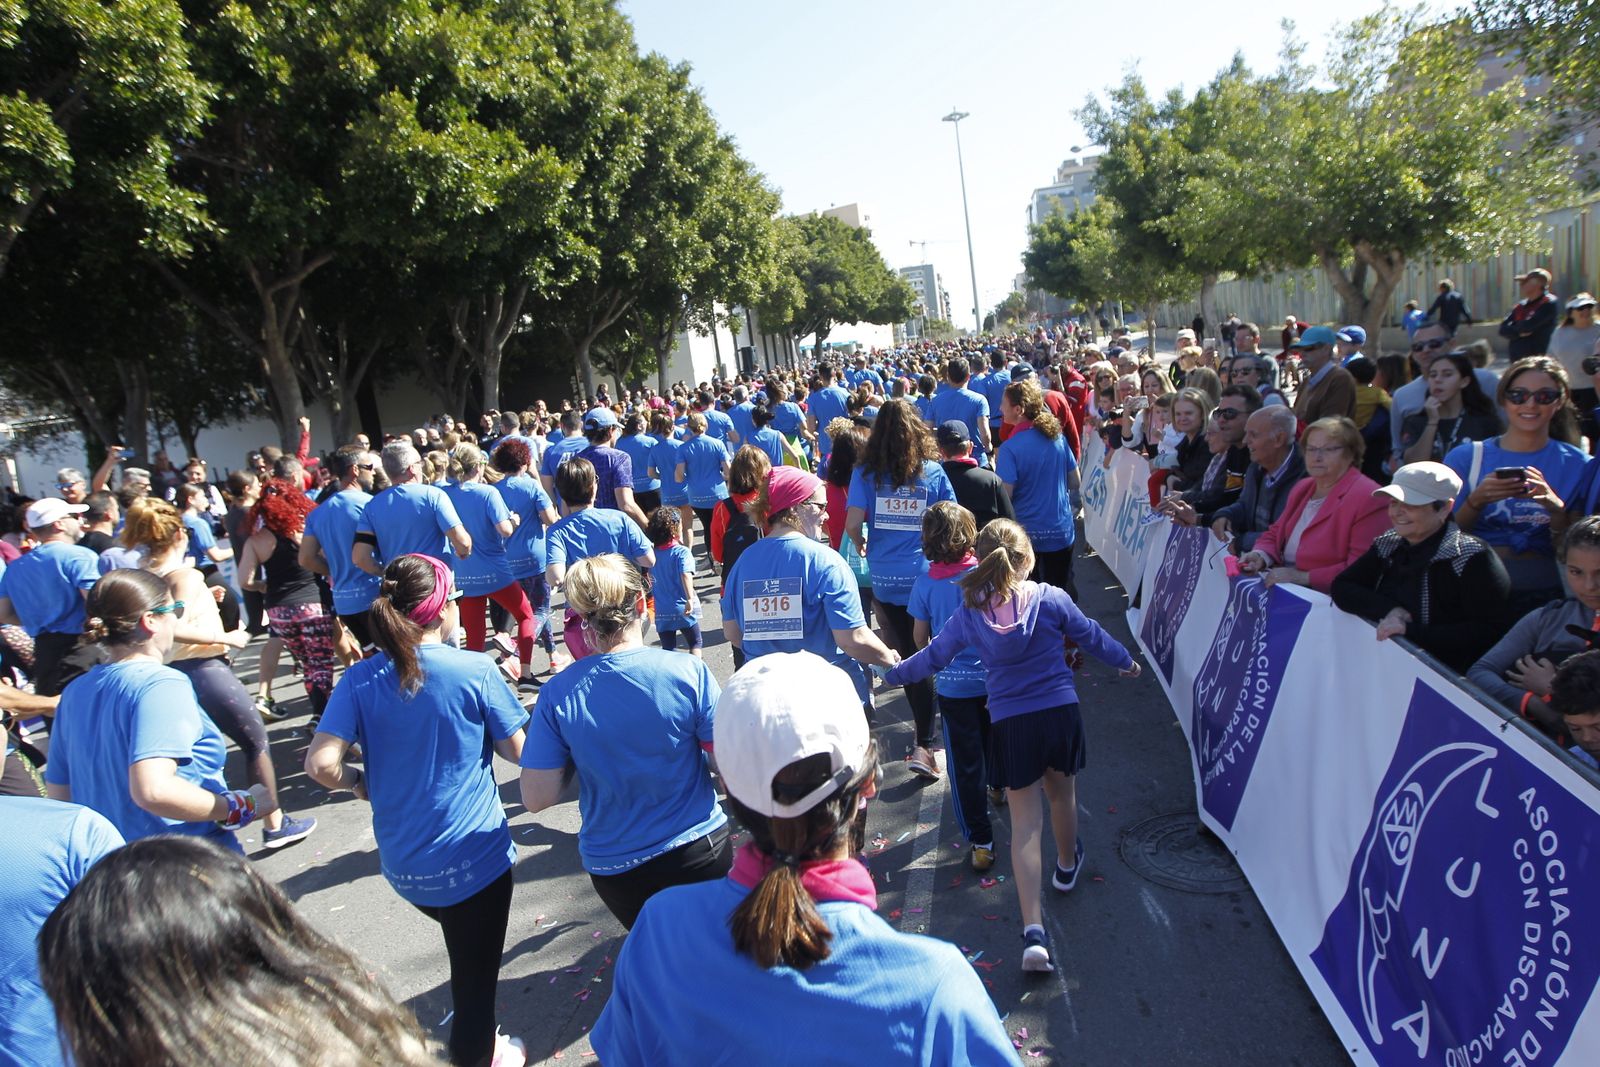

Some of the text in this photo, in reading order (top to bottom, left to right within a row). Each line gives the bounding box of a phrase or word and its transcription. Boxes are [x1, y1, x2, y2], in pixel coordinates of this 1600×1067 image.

[884, 498, 918, 511] 1314
[752, 596, 790, 613] 1316
[1224, 590, 1272, 765] ASOCIACIÓN DE LA
[1513, 838, 1541, 909] CON
[1503, 787, 1571, 1067] ASOCIACIÓN DE
